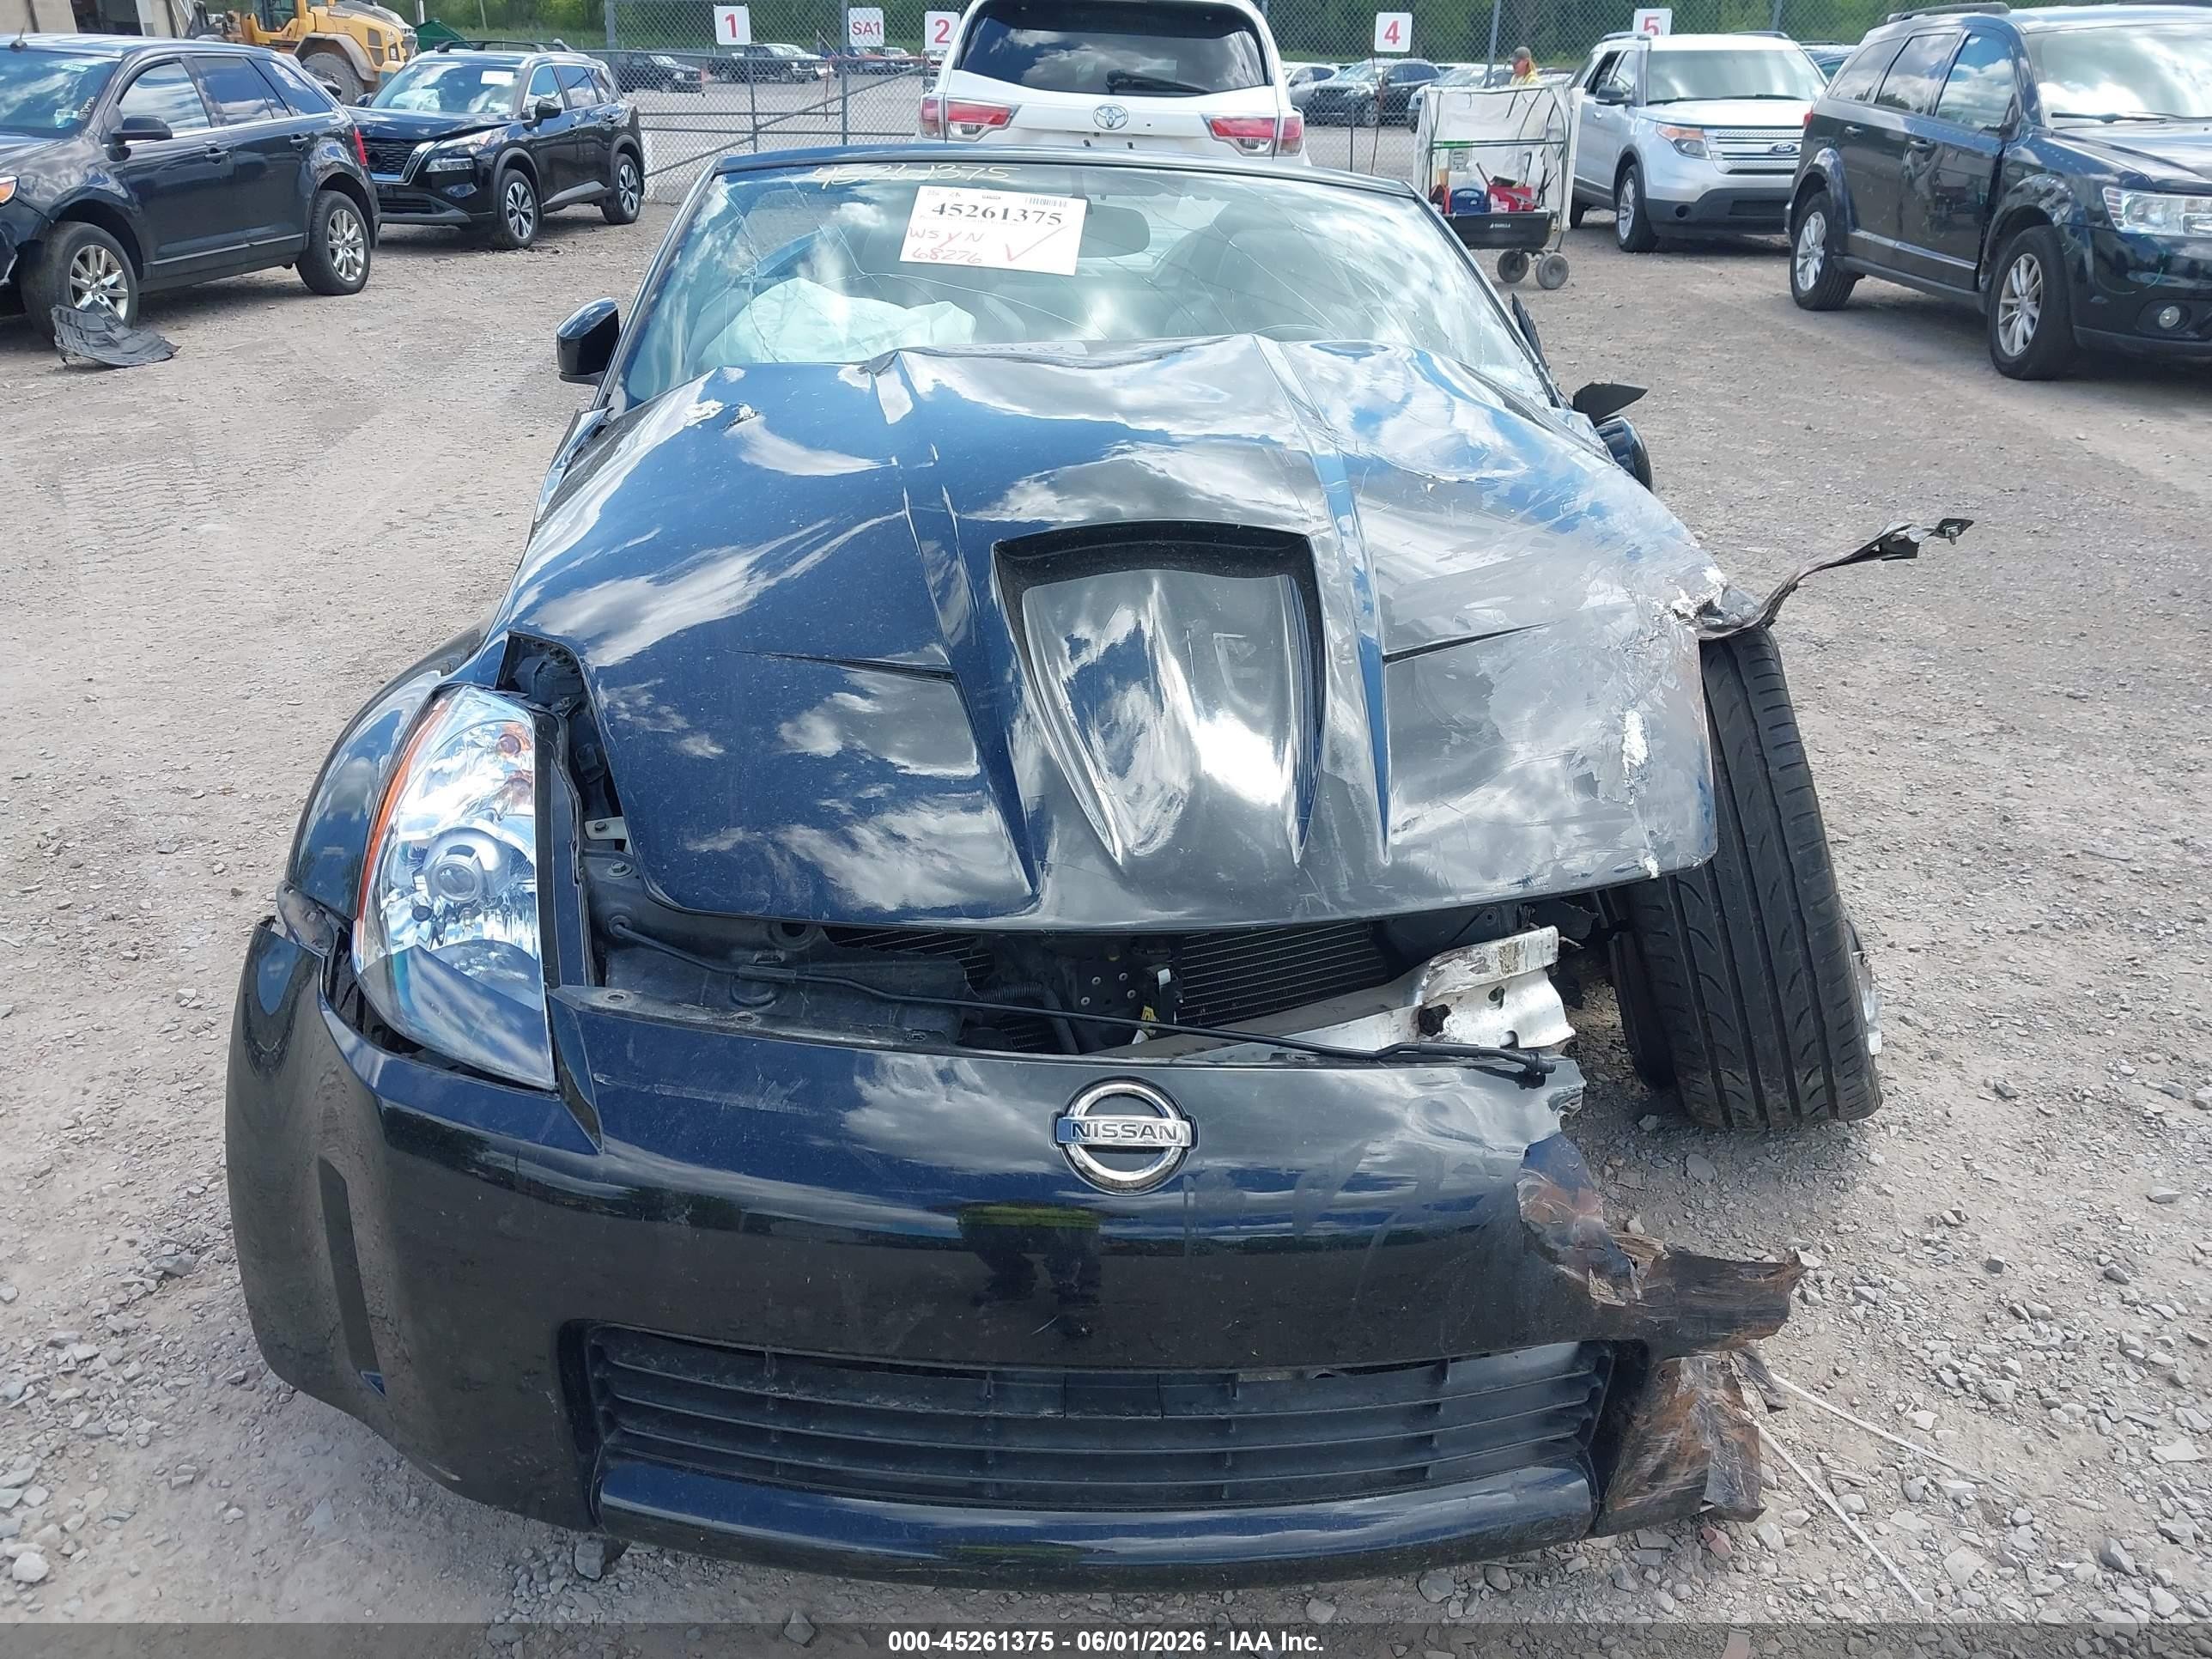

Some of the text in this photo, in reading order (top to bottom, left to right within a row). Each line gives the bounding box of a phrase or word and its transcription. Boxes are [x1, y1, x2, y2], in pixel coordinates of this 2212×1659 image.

[725, 14, 737, 39] 1
[852, 21, 881, 35] SA1
[934, 19, 951, 44] 2
[1384, 20, 1401, 45] 4
[1644, 16, 1659, 35] 5
[811, 163, 1021, 190] 45261375
[932, 202, 1062, 226] 45261375
[911, 246, 982, 264] 68276
[1072, 1122, 1177, 1140] NISSAN
